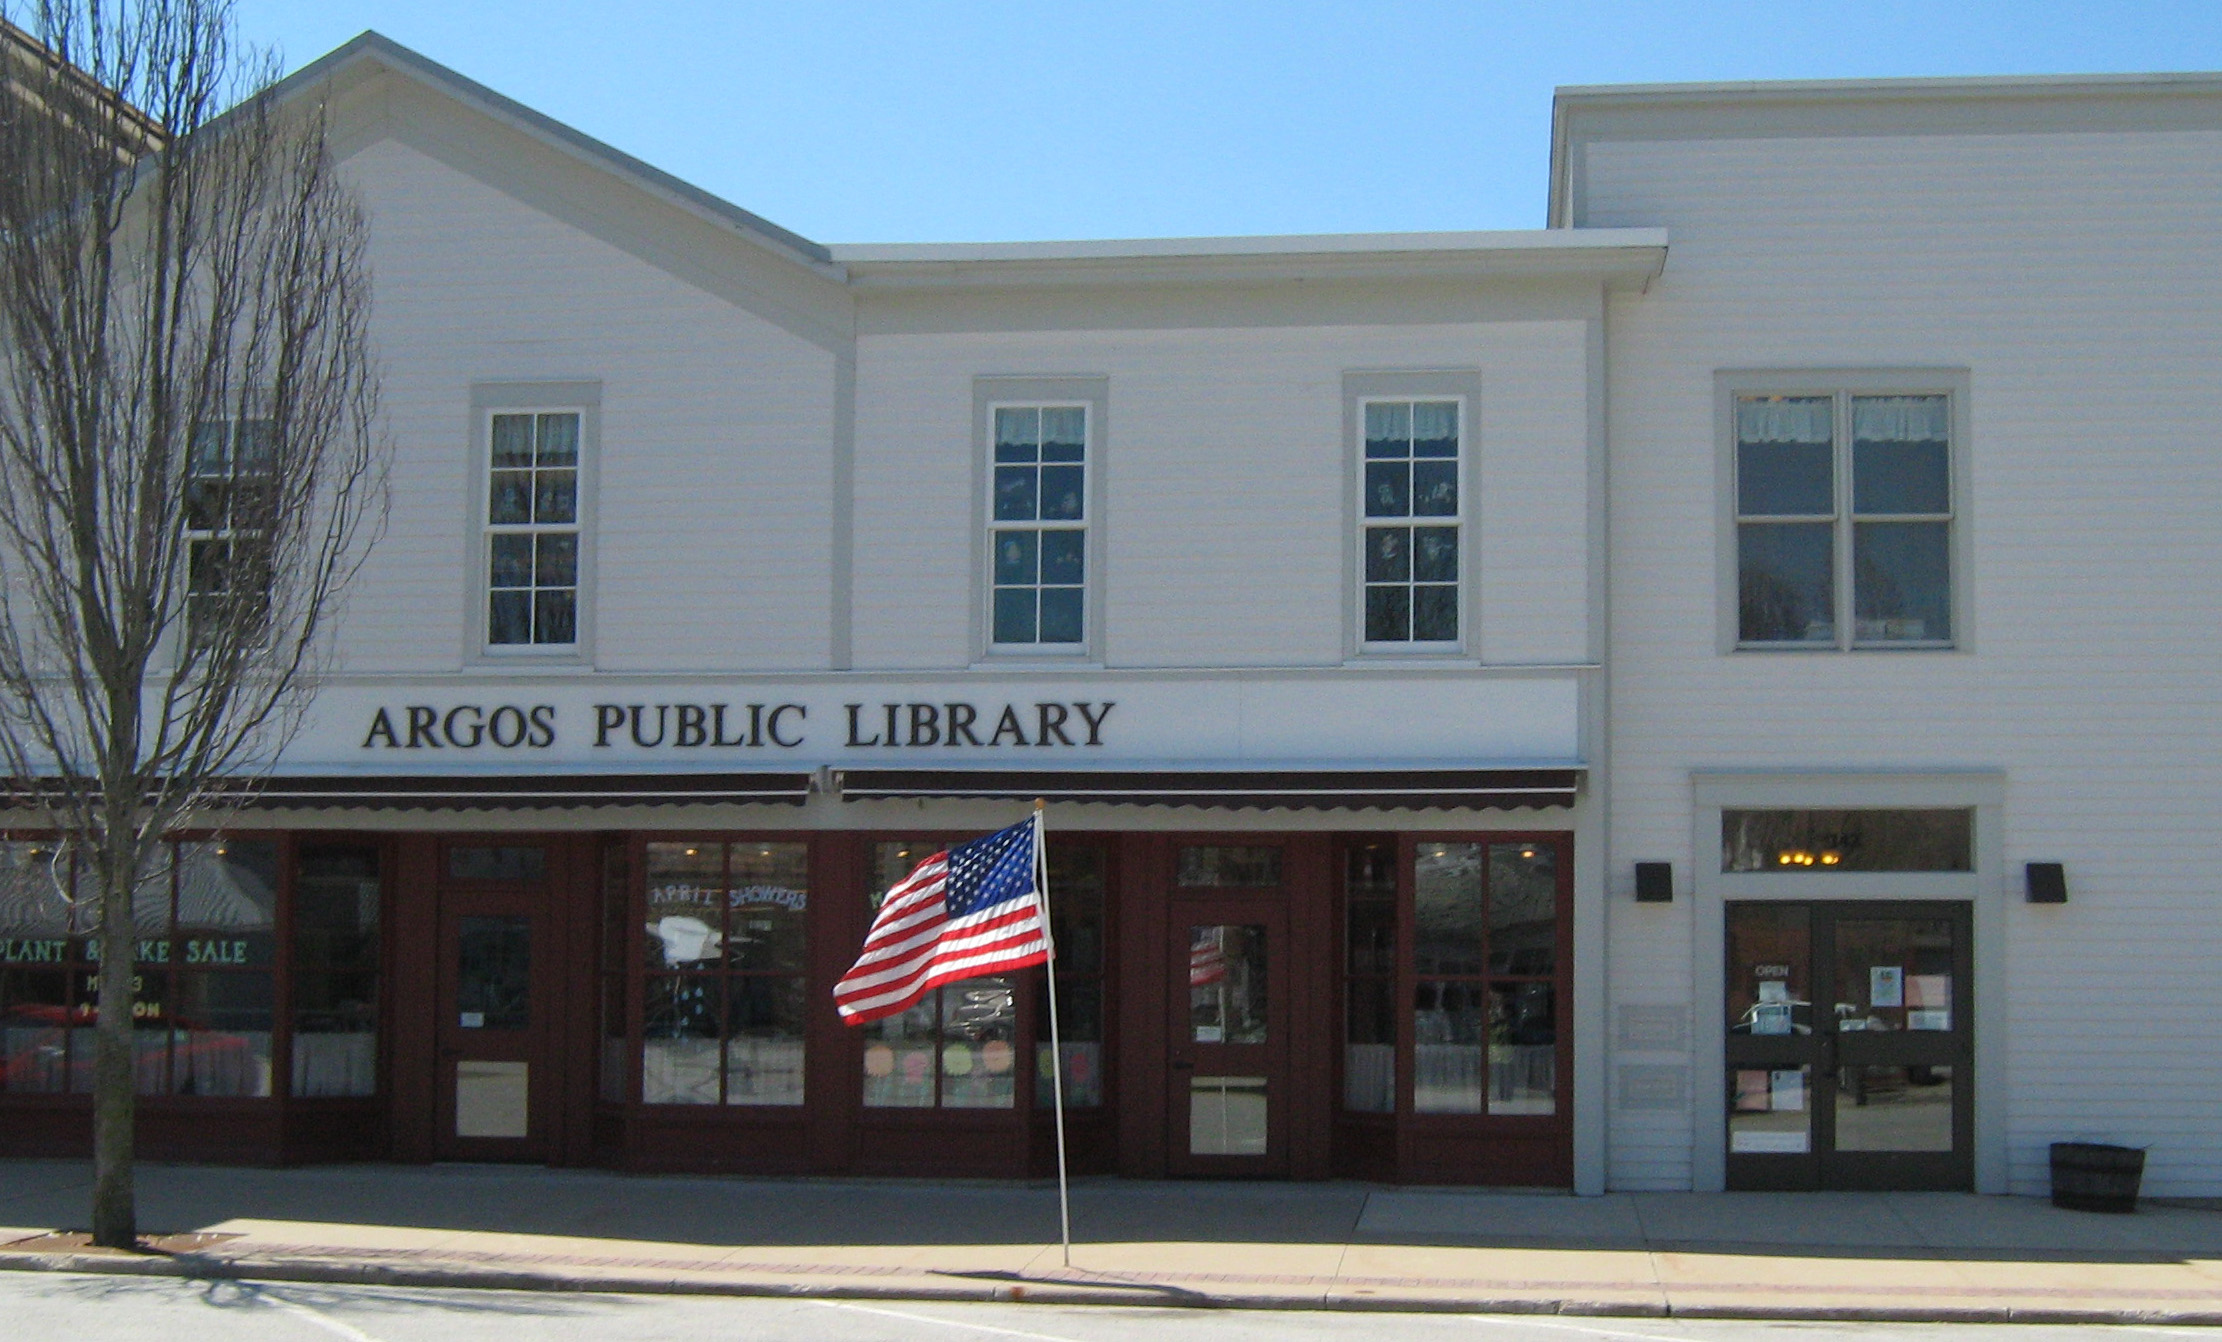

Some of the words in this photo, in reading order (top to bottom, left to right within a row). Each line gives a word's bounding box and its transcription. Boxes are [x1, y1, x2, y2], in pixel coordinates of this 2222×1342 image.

[362, 704, 556, 748] ARGOS
[593, 702, 807, 748] PUBLIC
[845, 701, 1116, 747] LIBRARY
[186, 940, 247, 963] SALE
[1755, 965, 1789, 977] OPEN
